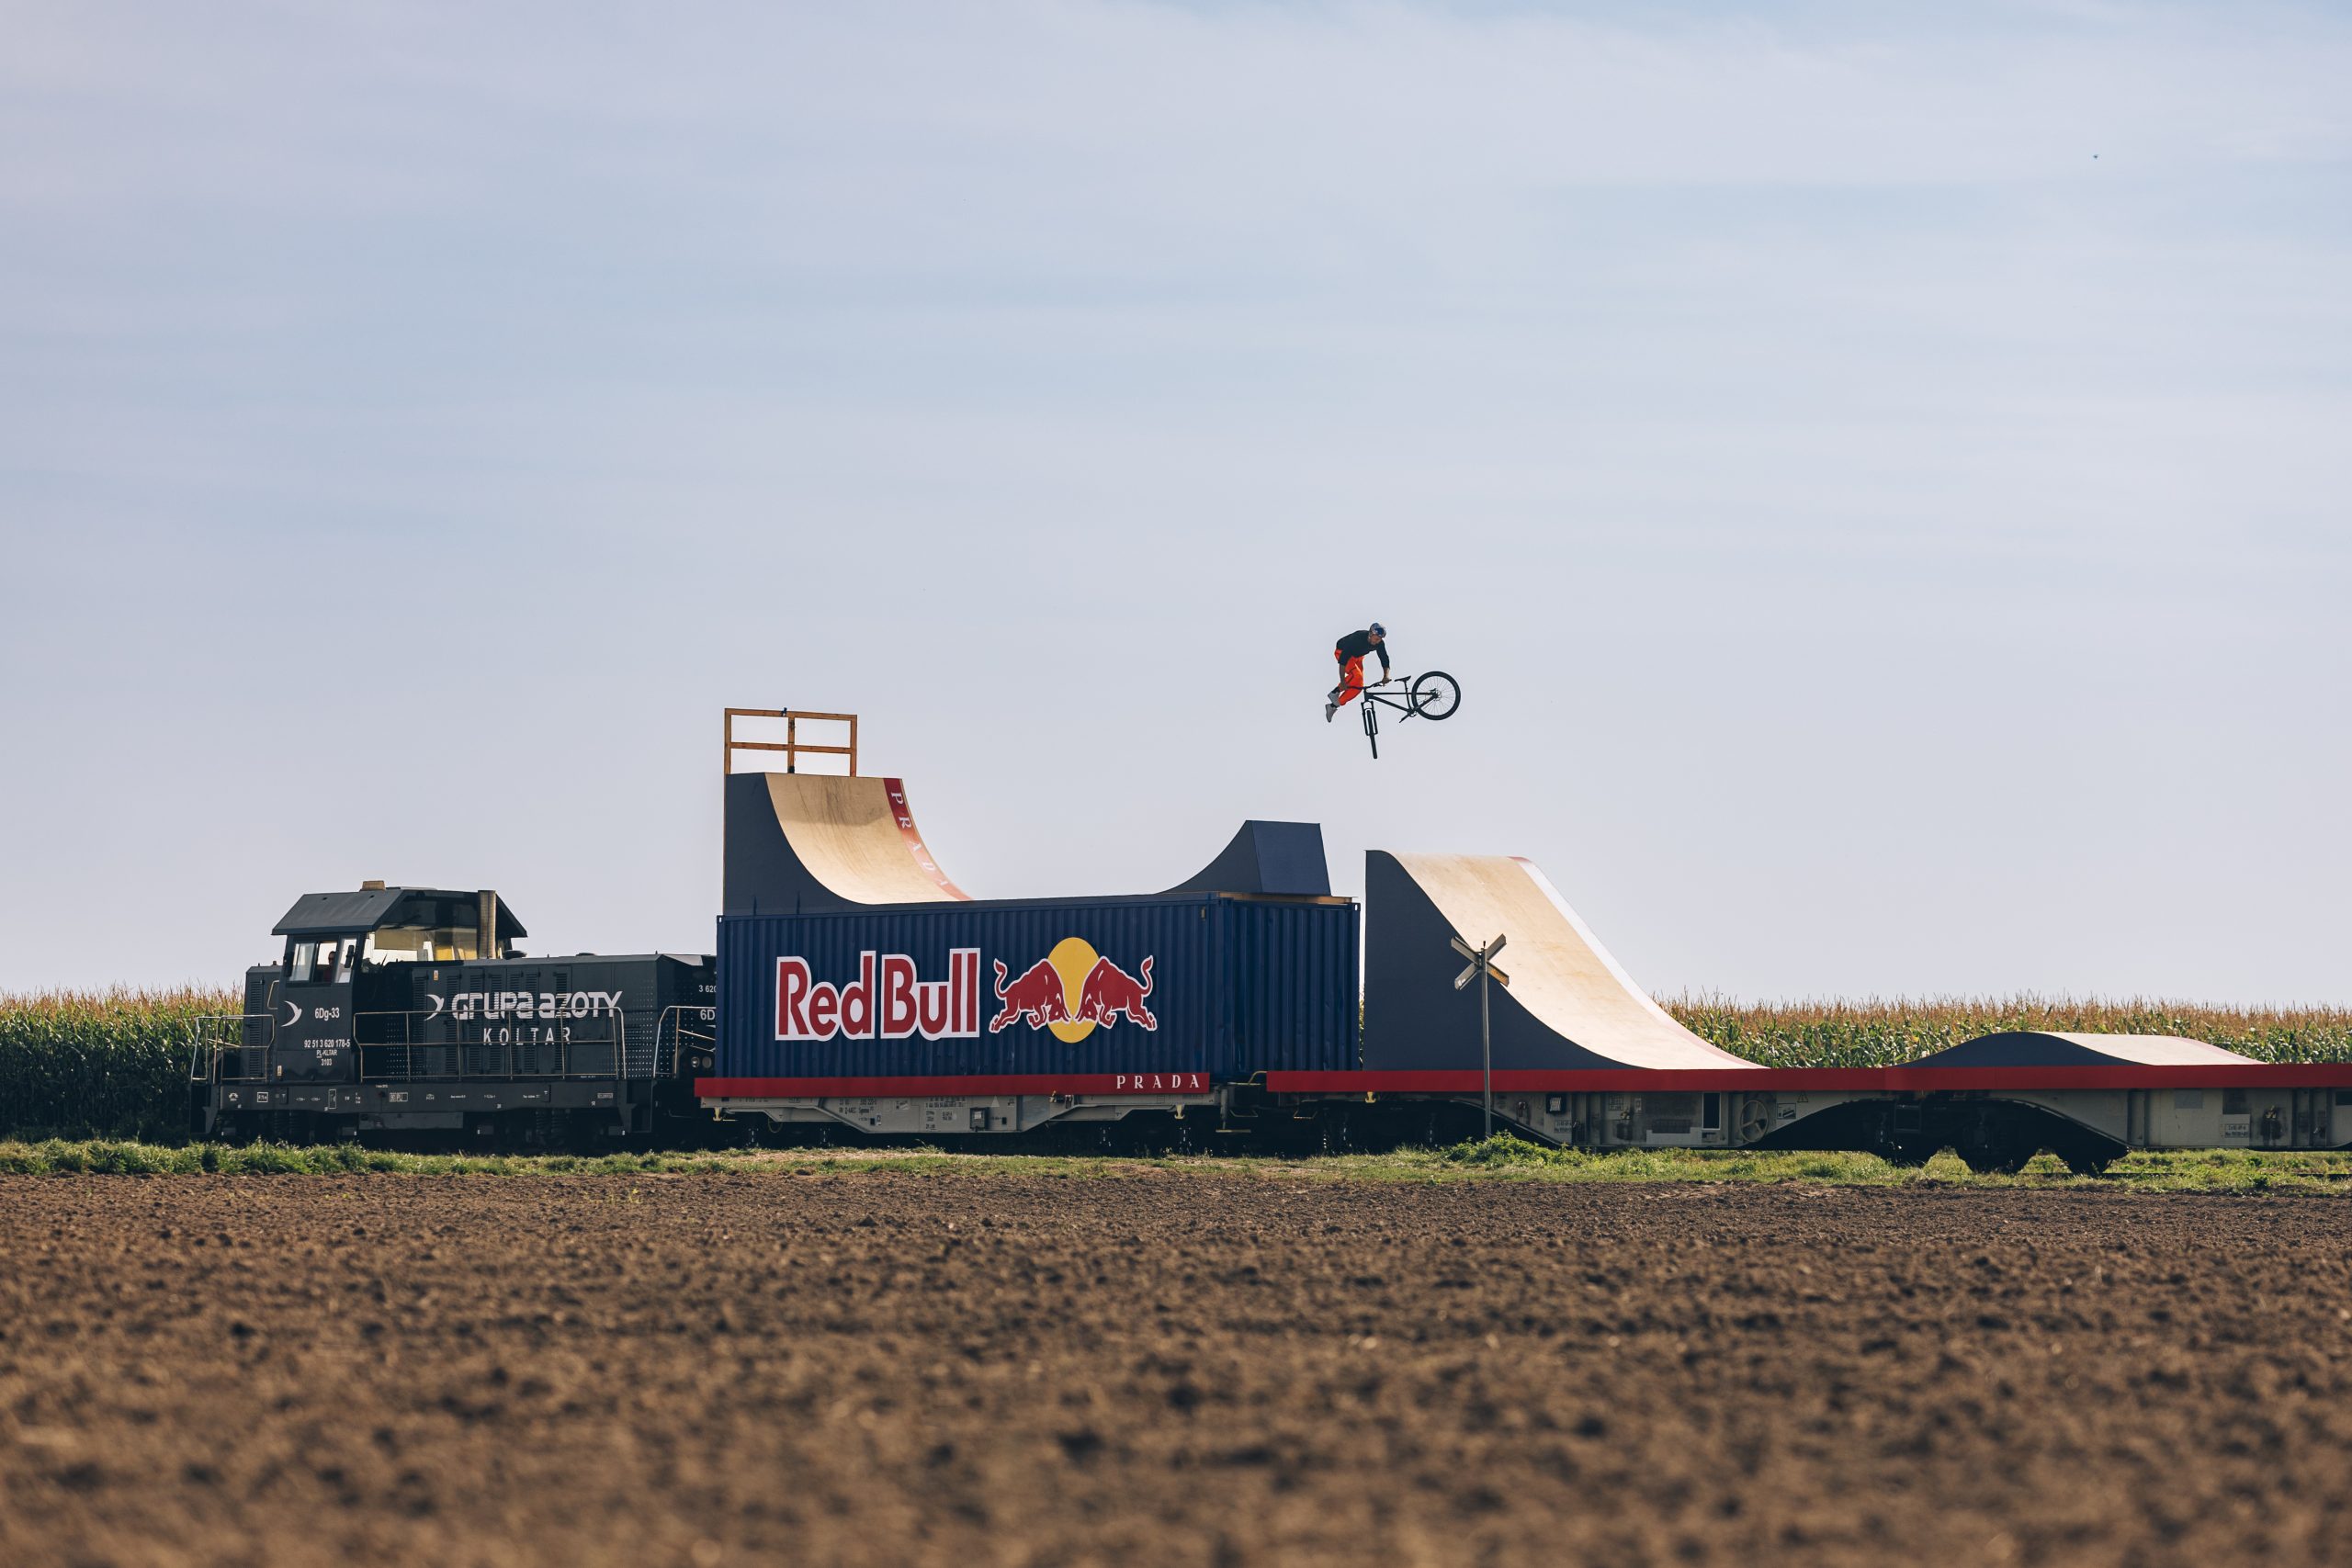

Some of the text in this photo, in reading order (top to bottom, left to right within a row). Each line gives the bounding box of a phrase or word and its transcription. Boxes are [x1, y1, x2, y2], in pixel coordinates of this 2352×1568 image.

[698, 984, 704, 993] 3
[777, 950, 978, 1038] Red Bull
[314, 1007, 340, 1021] 6Dg-33
[303, 1039, 311, 1048] 92
[483, 1027, 571, 1046] KOLTAR
[1116, 1074, 1199, 1089] PRADA
